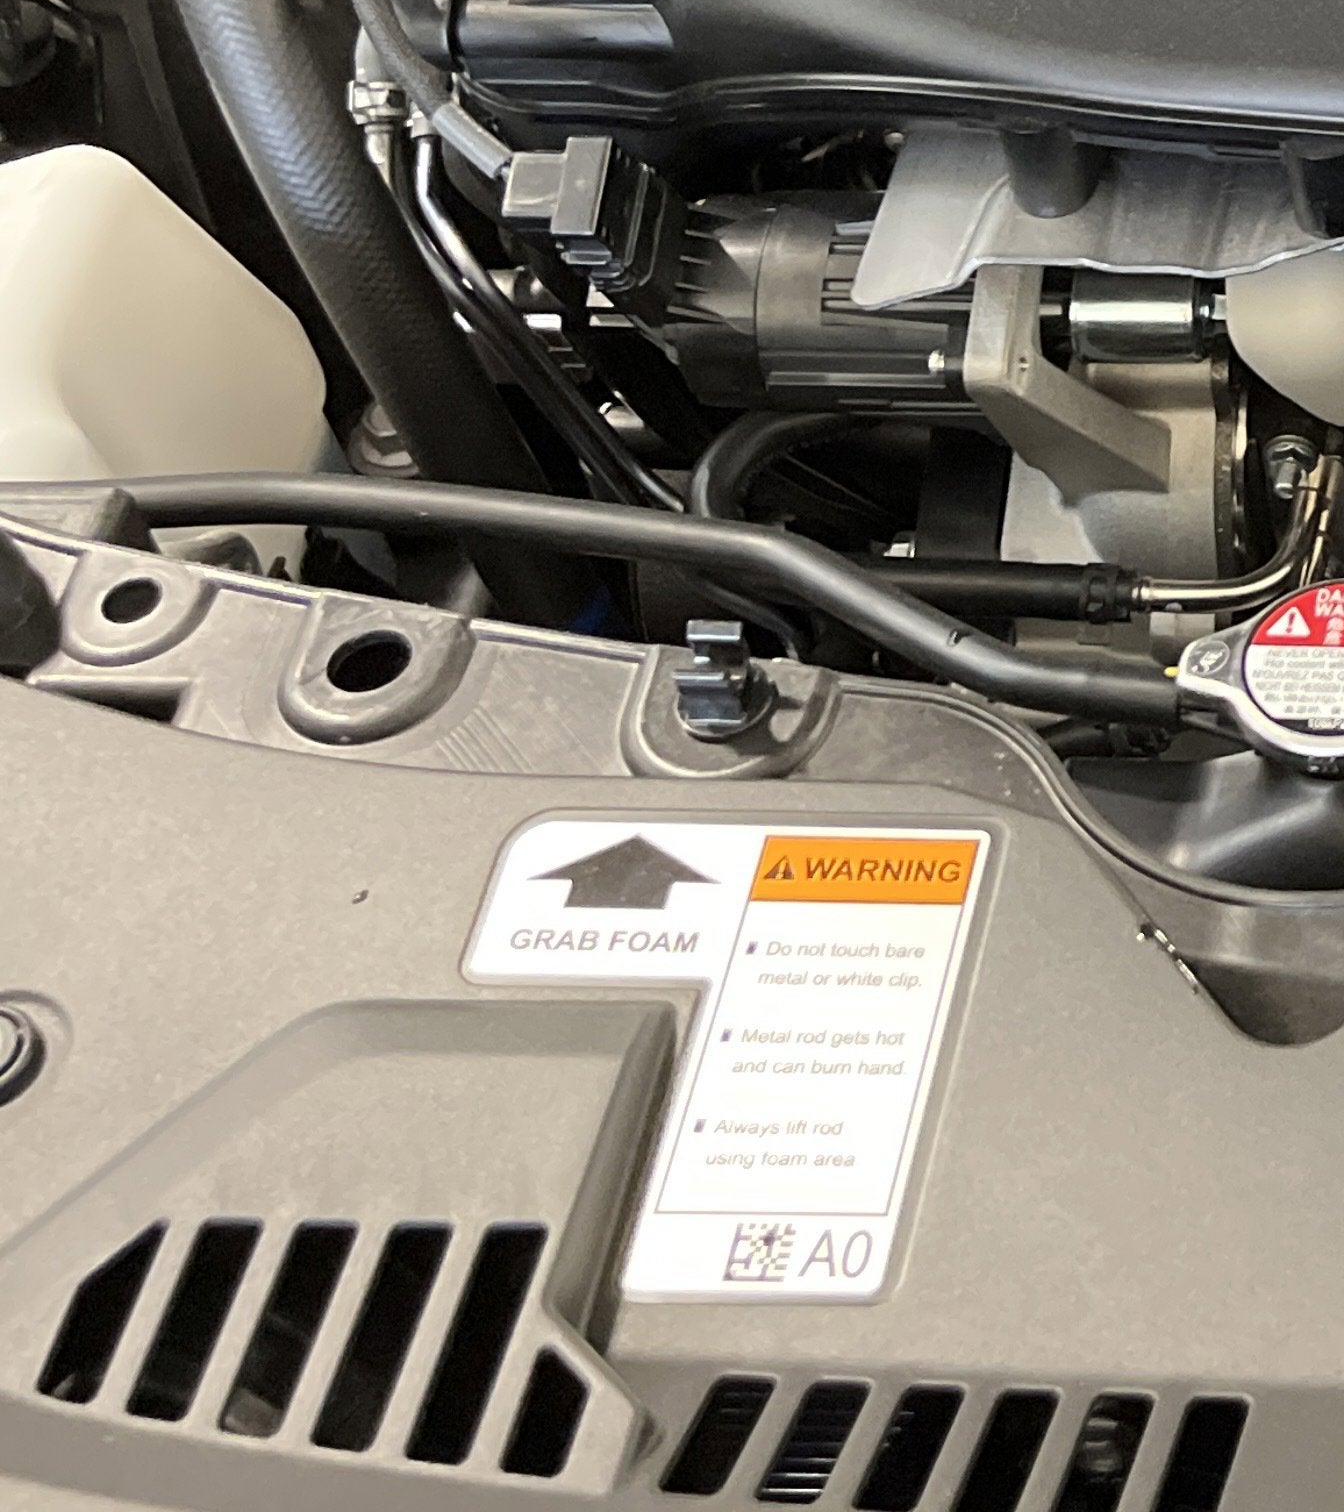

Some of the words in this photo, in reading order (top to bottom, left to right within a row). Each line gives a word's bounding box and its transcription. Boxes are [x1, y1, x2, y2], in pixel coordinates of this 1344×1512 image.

[1311, 670, 1334, 681] PAS
[805, 857, 962, 884] WARNING
[509, 928, 599, 952] GRAB
[607, 930, 701, 953] FOAM
[766, 941, 791, 958] Do
[797, 943, 826, 958] not
[830, 942, 880, 959] touch
[885, 943, 926, 960] bare
[757, 969, 807, 986] metal
[812, 973, 832, 986] or
[836, 970, 883, 987] white
[888, 971, 923, 991] clip.
[741, 1028, 789, 1045] Metal
[796, 1029, 829, 1045] rod
[831, 1031, 871, 1048] gets
[875, 1029, 906, 1046] hot
[731, 1059, 767, 1074] and
[772, 1061, 805, 1075] can
[811, 1059, 852, 1075] burn
[713, 1119, 780, 1138] Always
[786, 1119, 808, 1136] lift
[813, 1119, 844, 1136] rod
[705, 1152, 755, 1170] using
[761, 1151, 808, 1167] foam
[813, 1153, 856, 1167] area
[797, 1228, 873, 1279] A0
